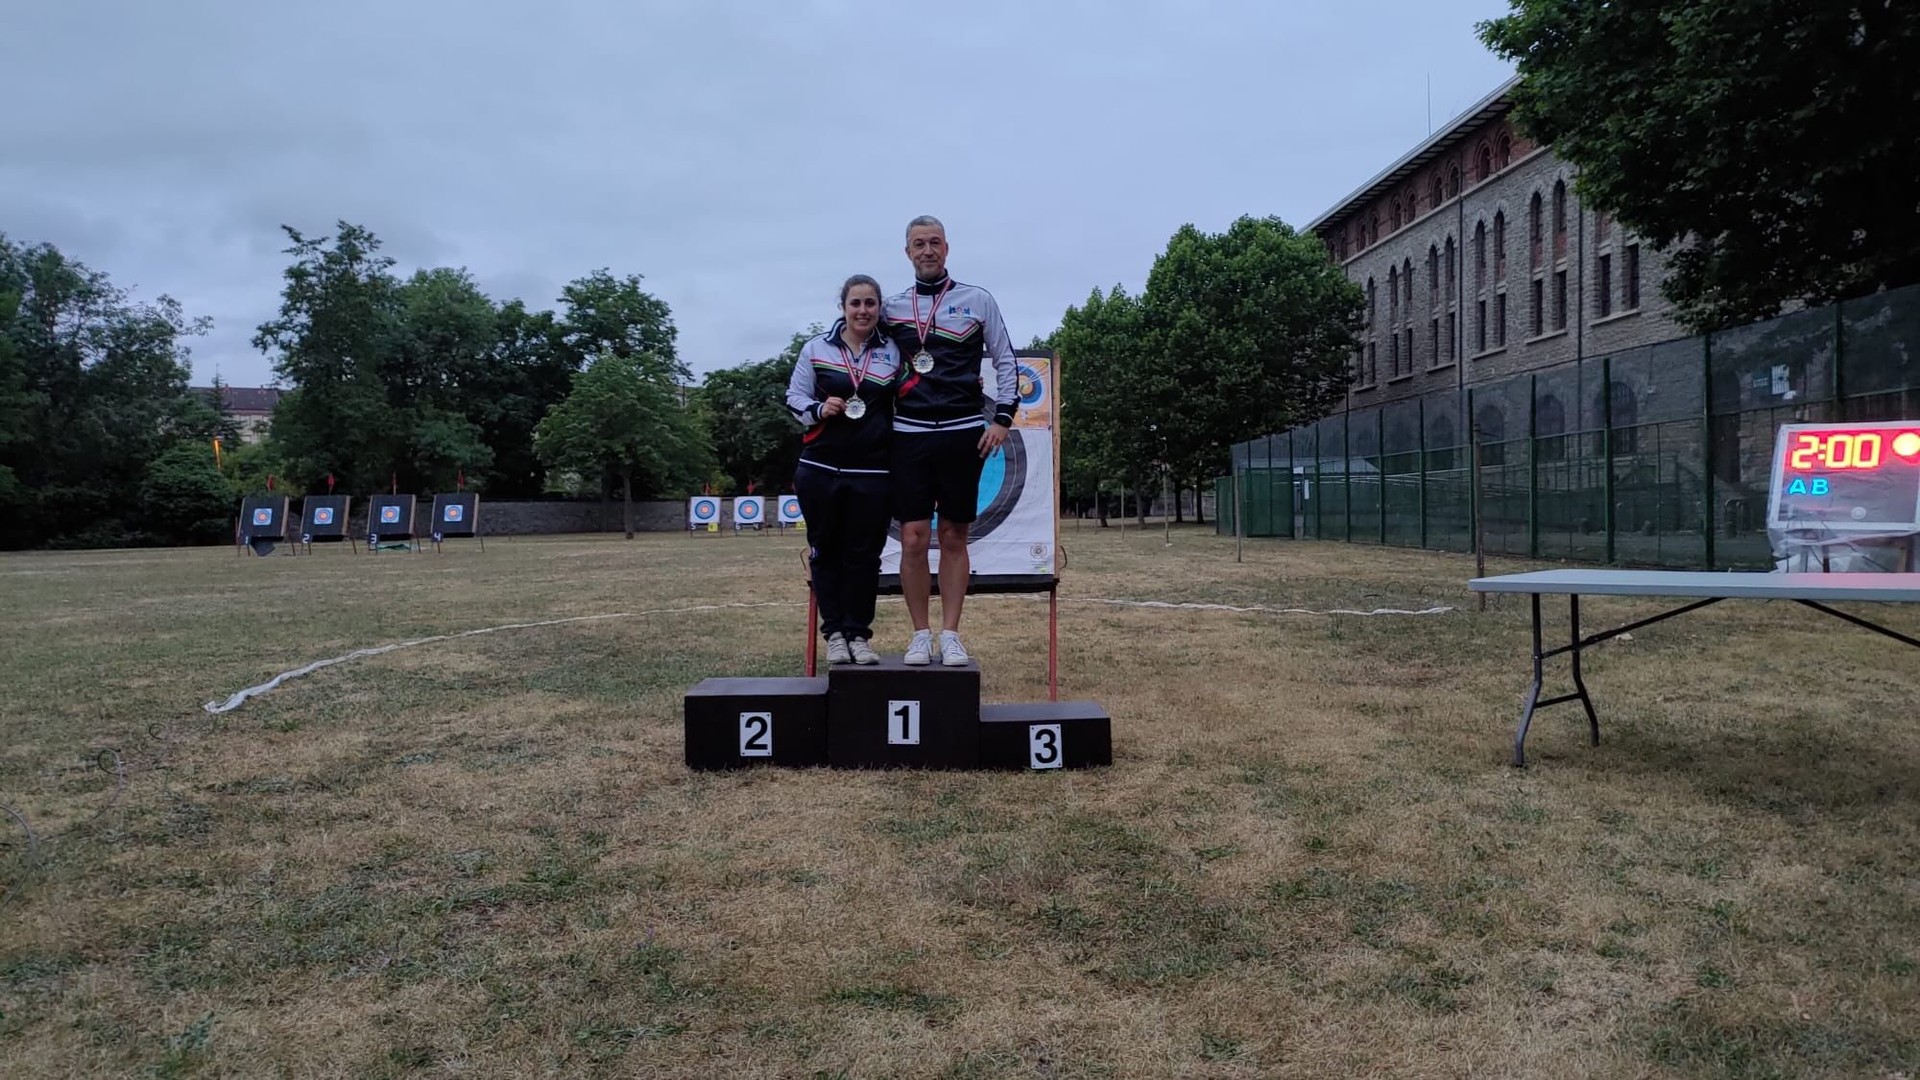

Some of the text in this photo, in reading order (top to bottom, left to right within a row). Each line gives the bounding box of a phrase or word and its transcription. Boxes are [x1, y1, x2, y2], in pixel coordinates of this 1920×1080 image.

[1792, 433, 1881, 468] 2:00
[302, 533, 310, 544] 2
[370, 533, 377, 544] 3
[434, 532, 441, 541] 4
[744, 716, 768, 750] 2
[893, 705, 910, 740] 1
[1034, 728, 1058, 764] 3
